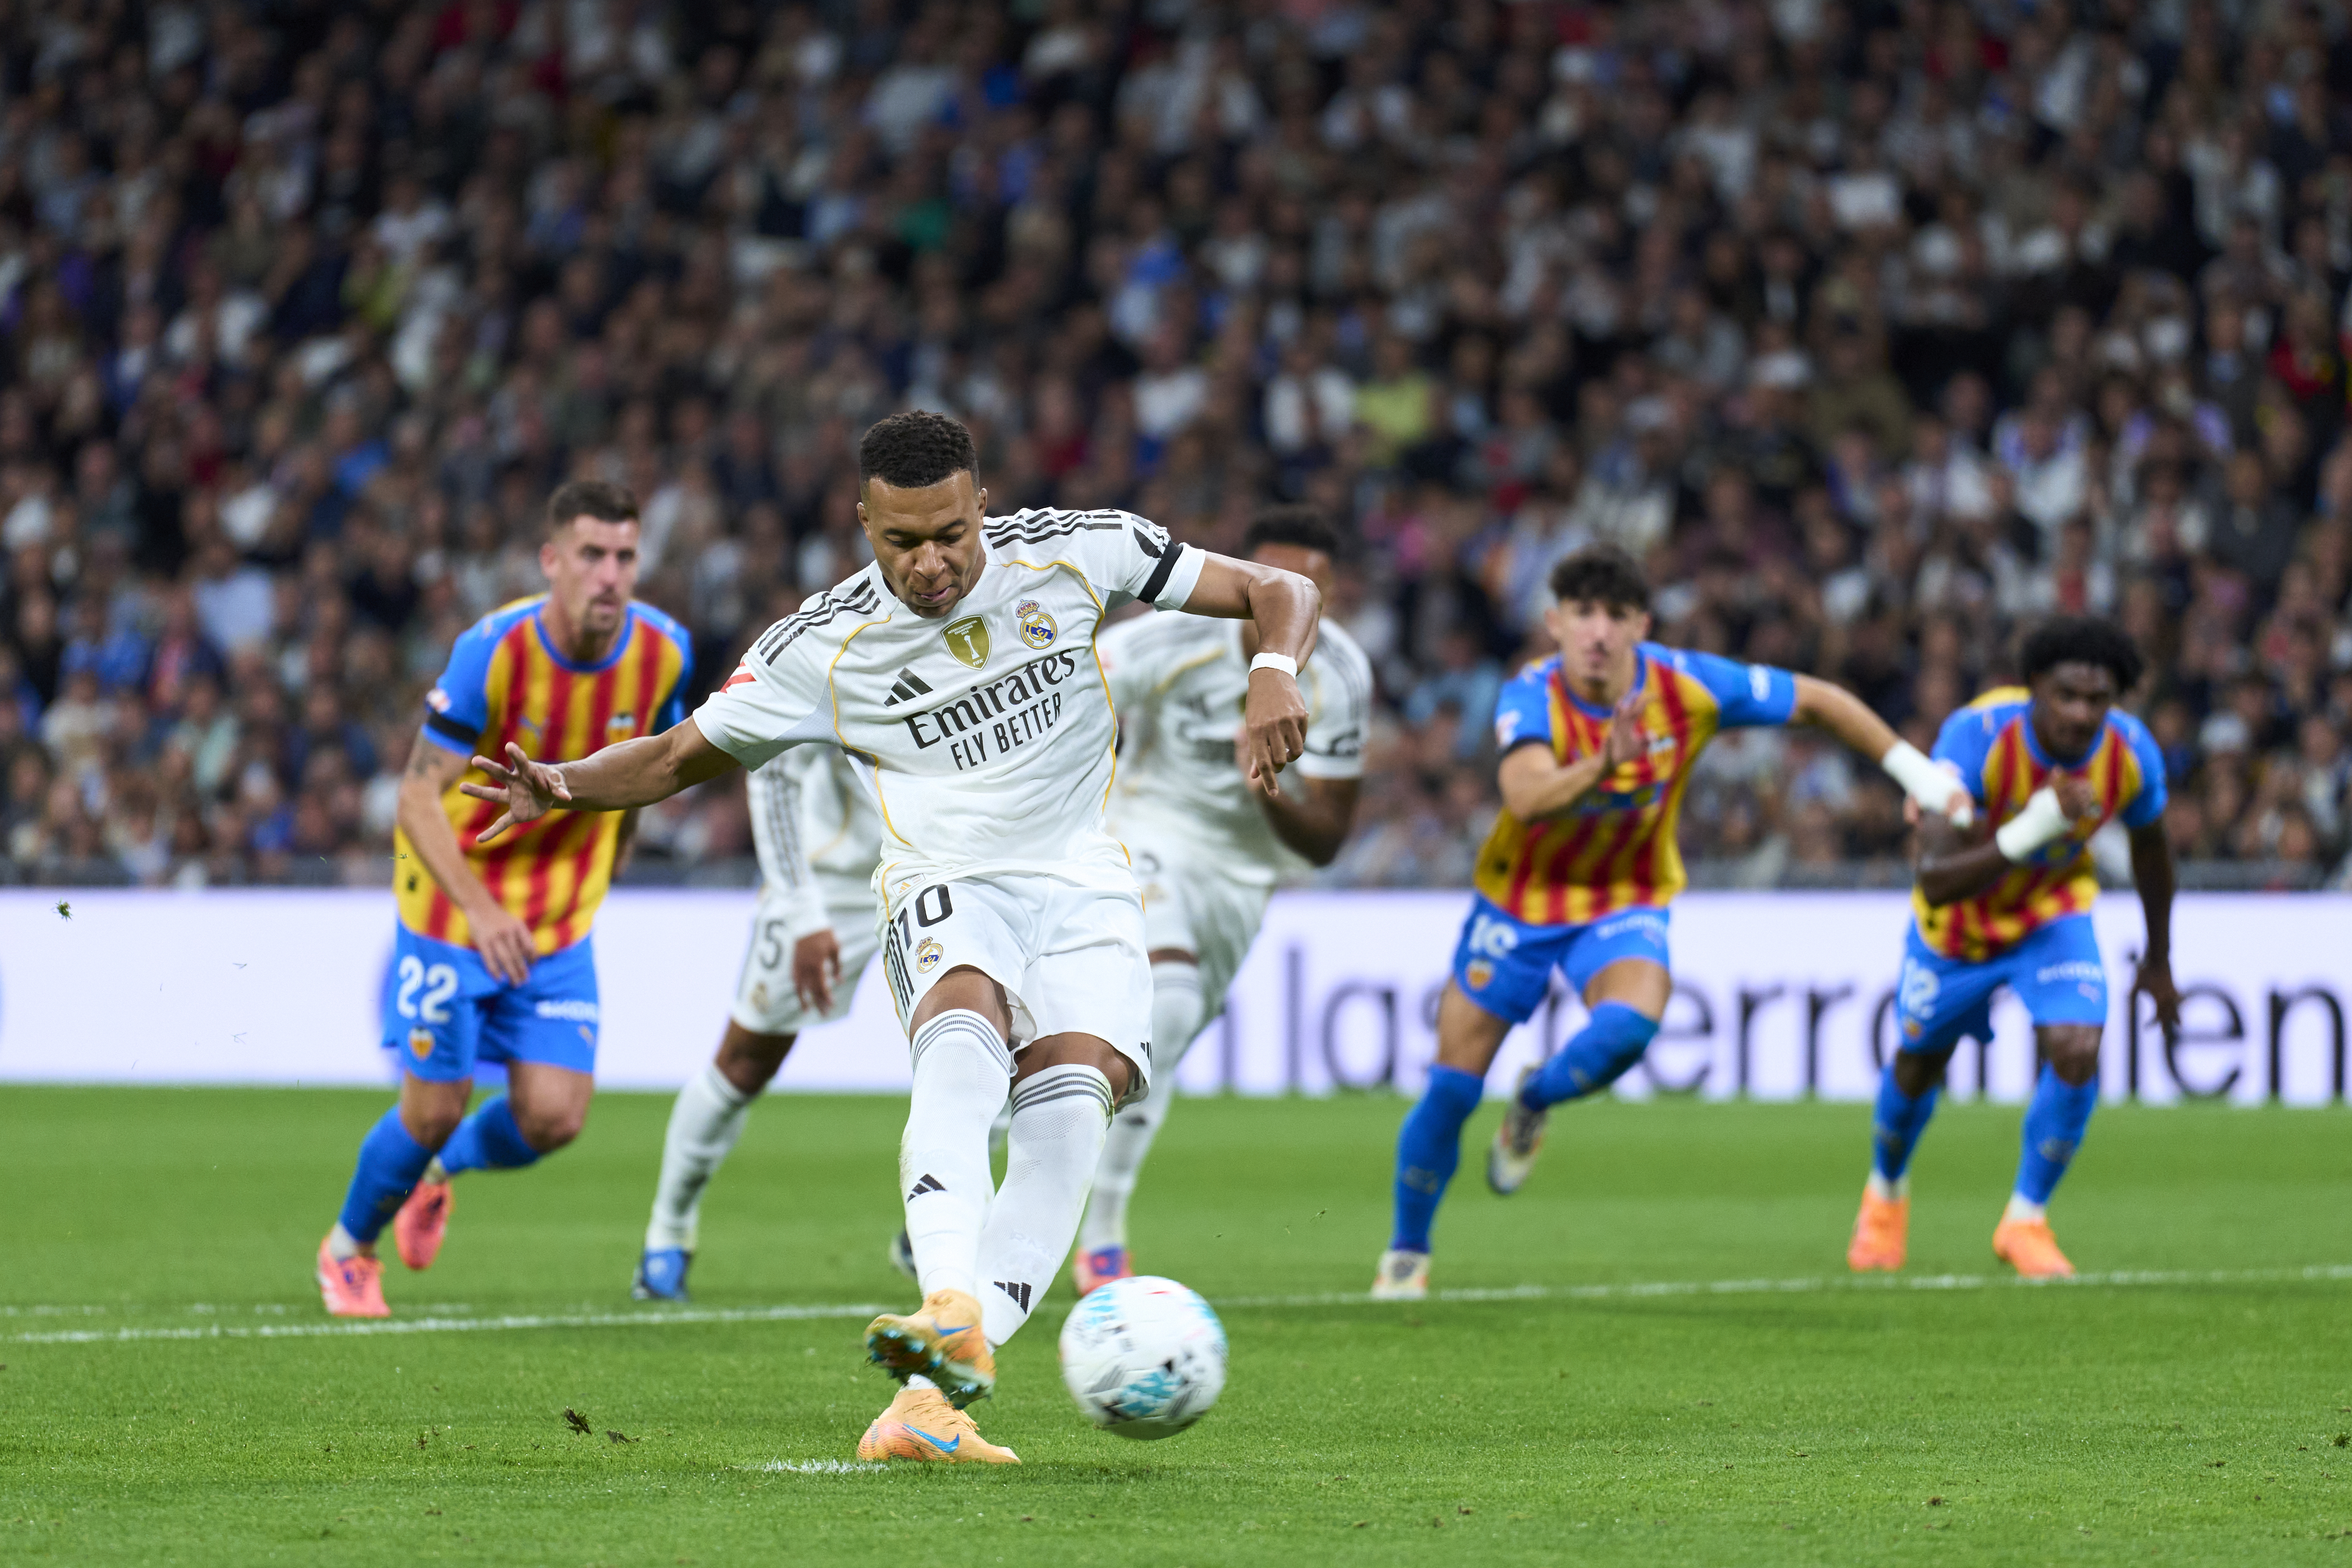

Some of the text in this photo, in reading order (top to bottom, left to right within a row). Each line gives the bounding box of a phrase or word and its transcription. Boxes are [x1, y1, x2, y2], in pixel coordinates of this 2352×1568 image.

[947, 620, 978, 634] INTERCONTINENTAL
[954, 625, 973, 635] CHAMPIONS
[903, 648, 1075, 749] Emirates
[950, 692, 1061, 771] FLY BETTER
[897, 884, 953, 952] 10
[396, 955, 458, 1023] 22
